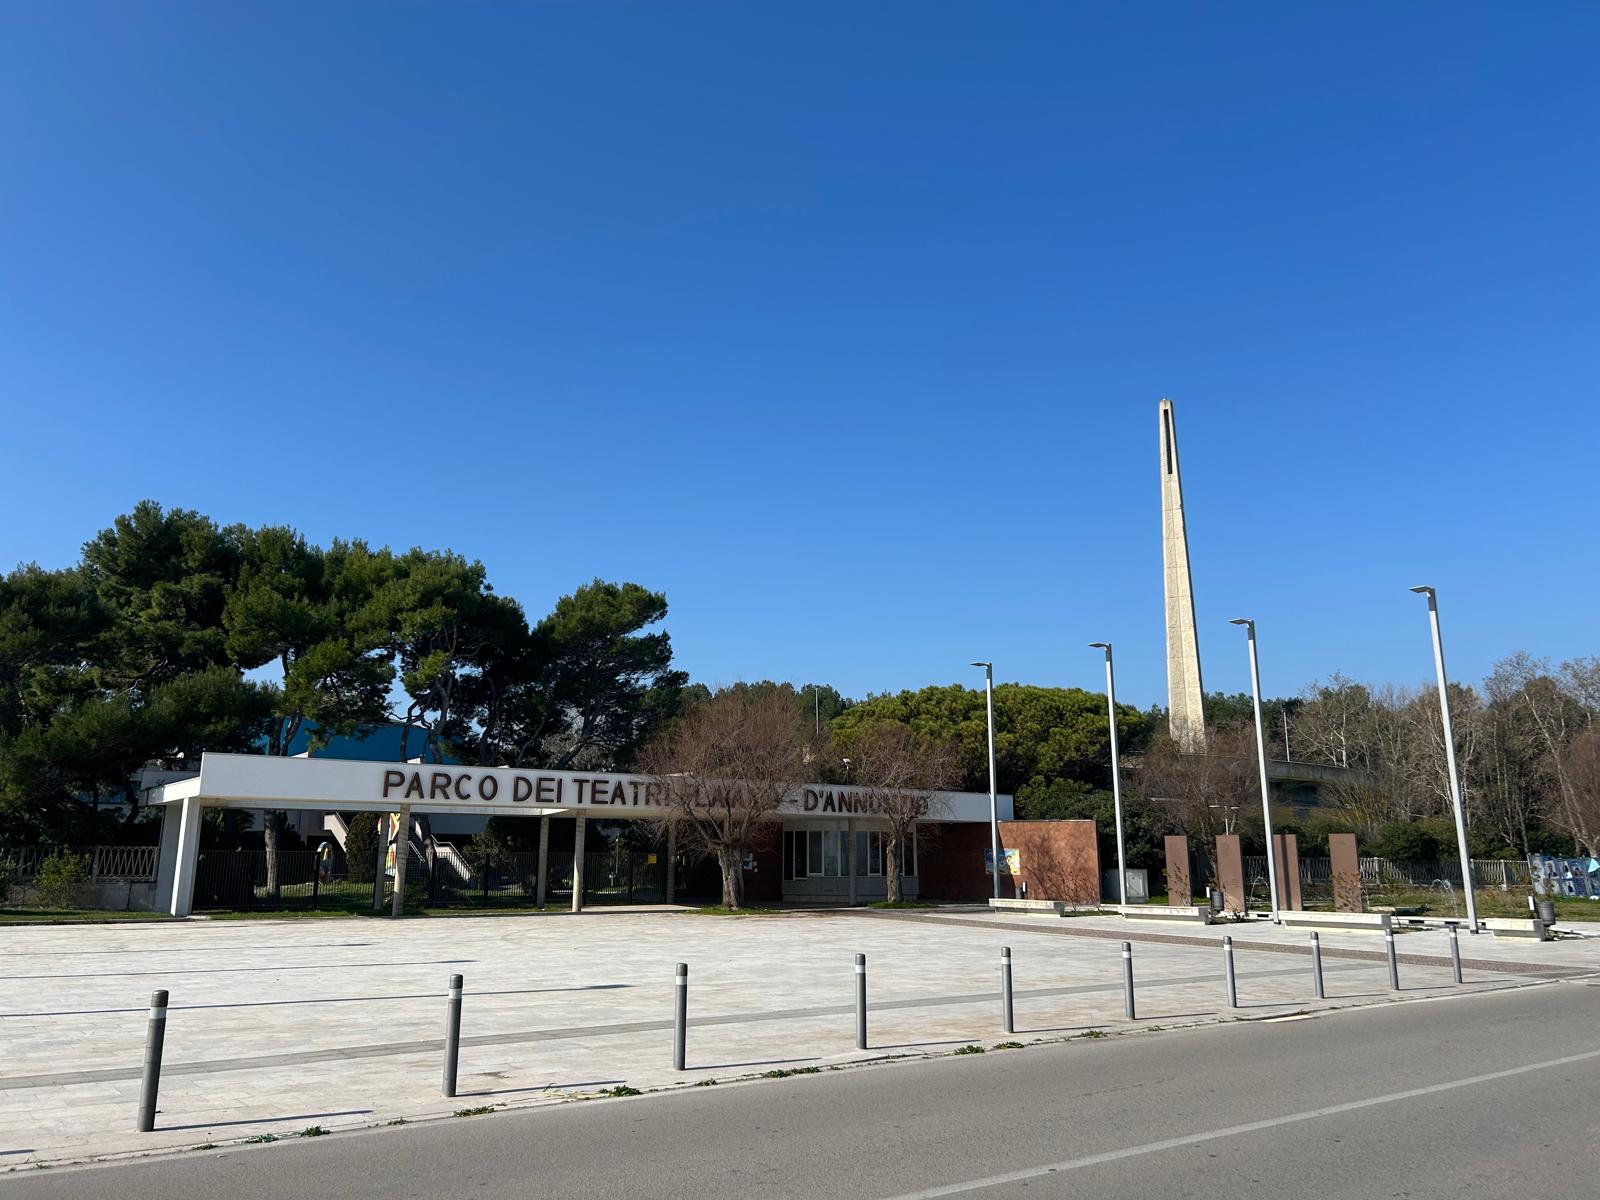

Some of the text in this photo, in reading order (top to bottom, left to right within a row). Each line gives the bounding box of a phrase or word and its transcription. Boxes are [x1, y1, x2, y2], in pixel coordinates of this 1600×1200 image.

[382, 770, 499, 801] PARCO
[512, 776, 563, 803] DEI
[572, 778, 671, 807] TEATRI
